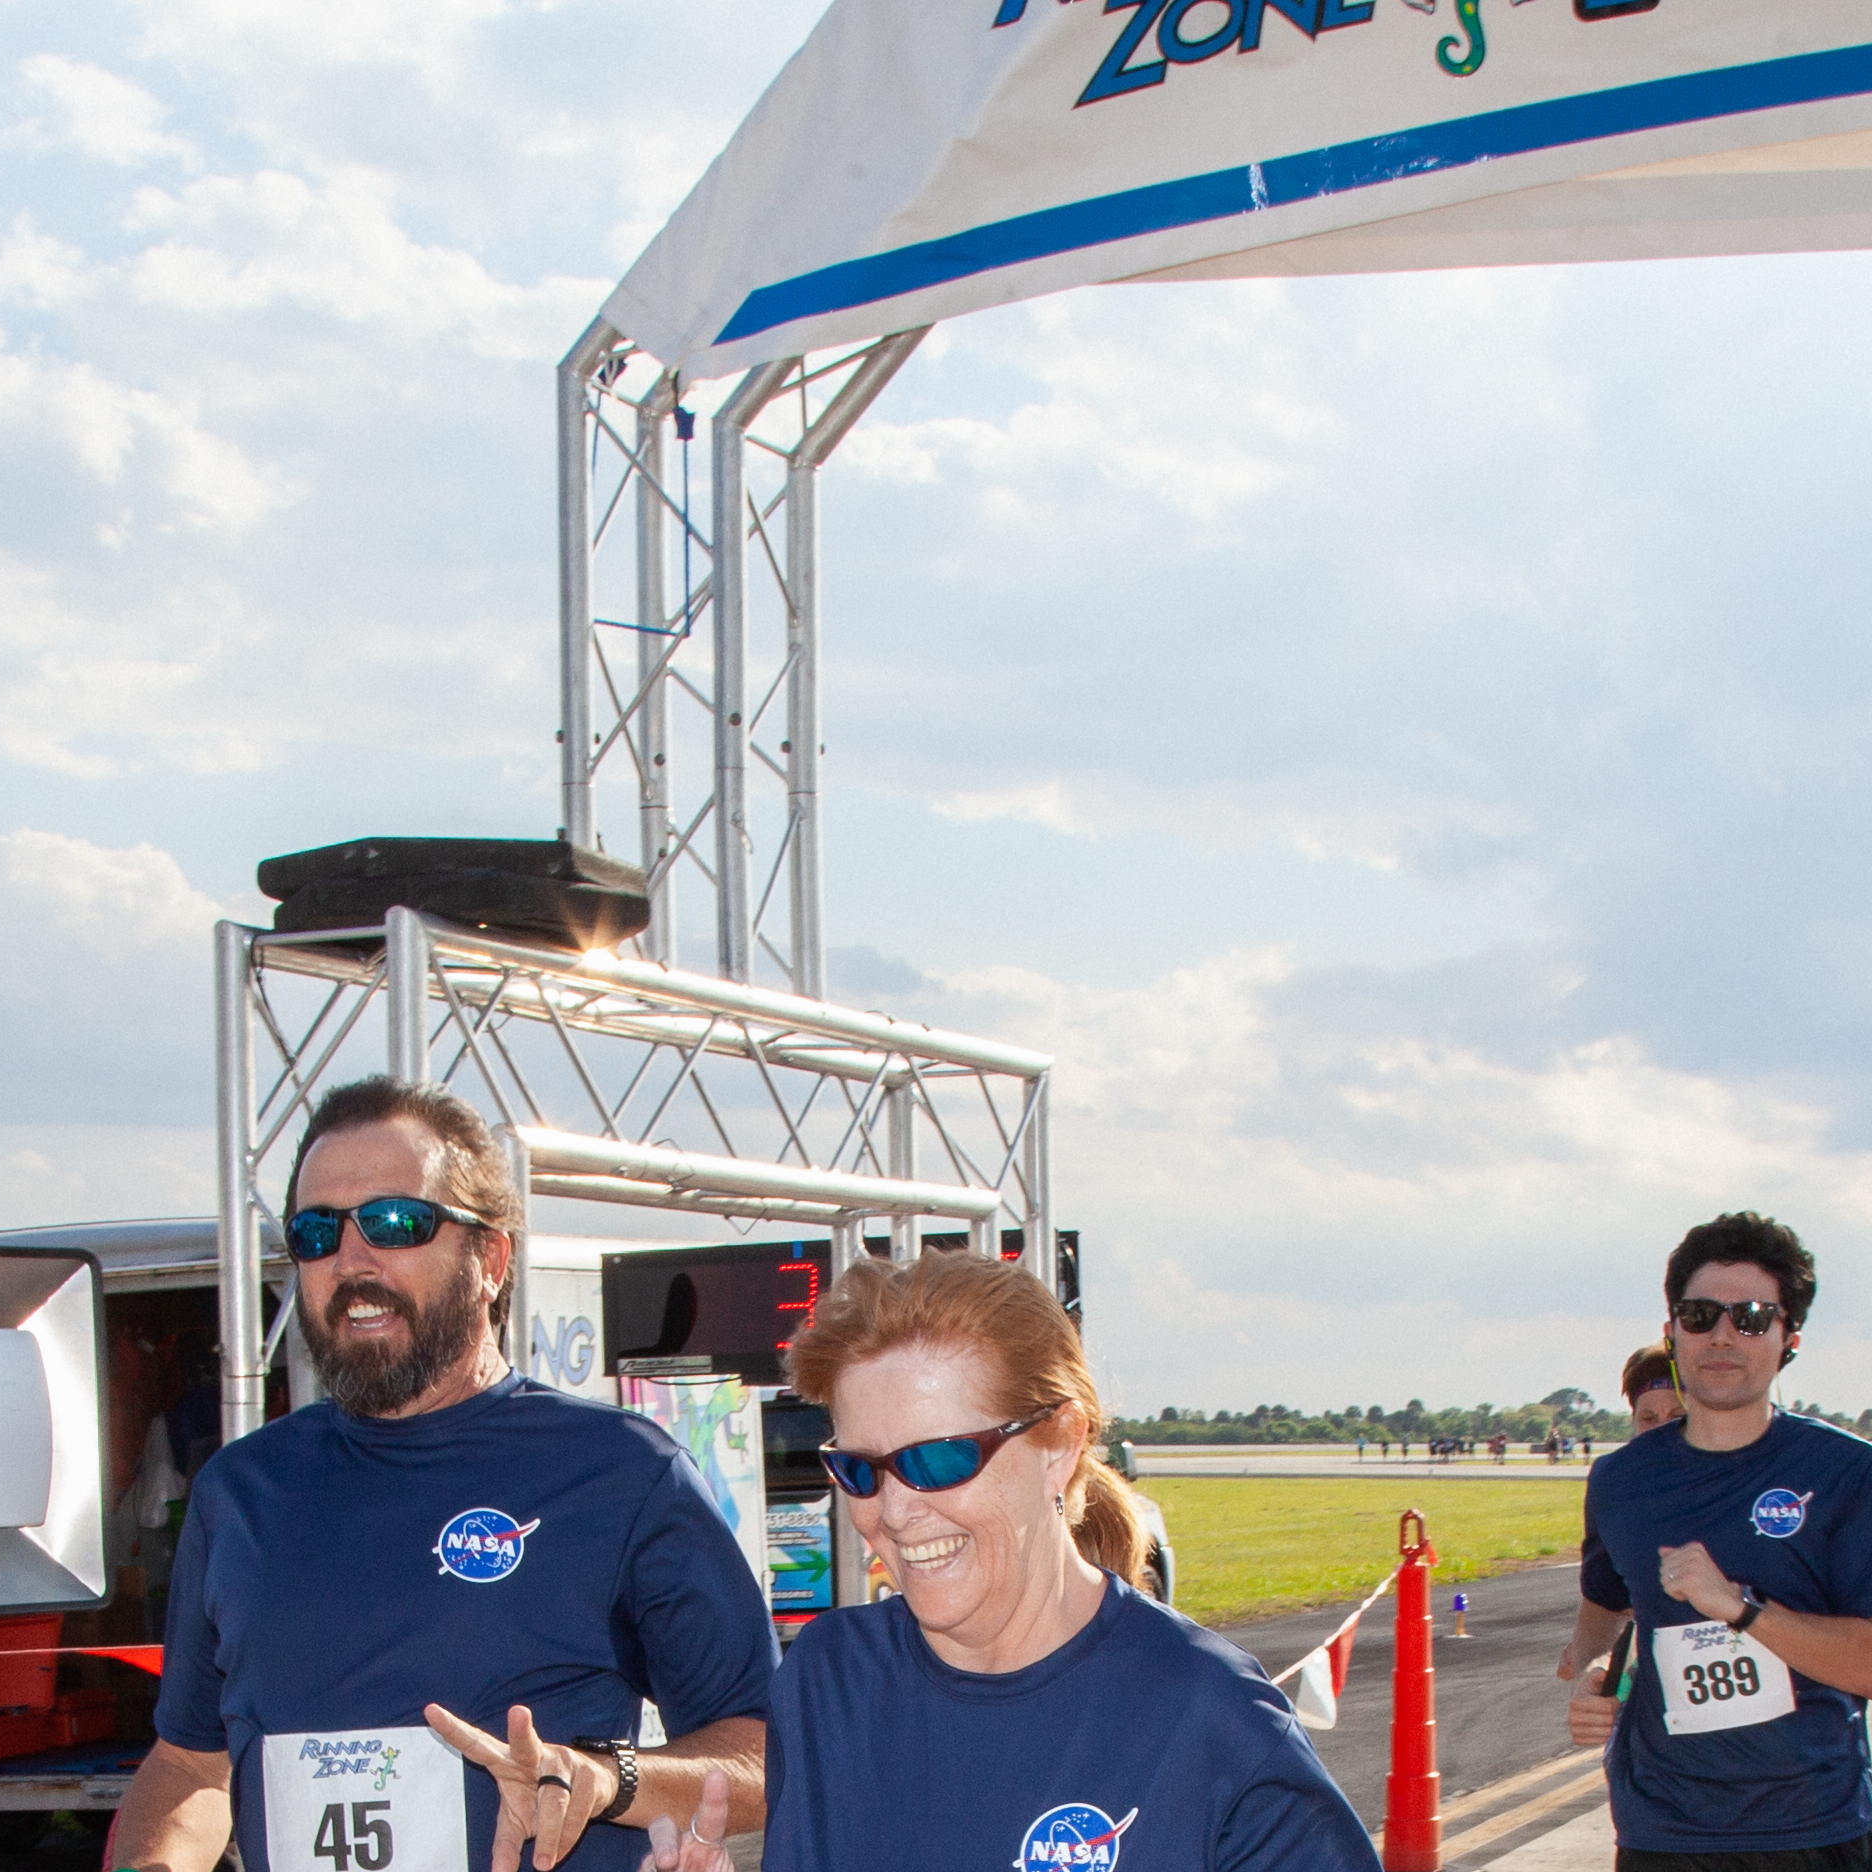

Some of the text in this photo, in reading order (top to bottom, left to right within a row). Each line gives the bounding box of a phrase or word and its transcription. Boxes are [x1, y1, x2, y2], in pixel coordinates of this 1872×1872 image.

[1758, 1507, 1800, 1518] NASA
[447, 1533, 516, 1558] NASA
[1683, 1656, 1760, 1705] 389
[312, 1758, 372, 1779] ZONE
[313, 1800, 393, 1872] 45
[1030, 1841, 1110, 1864] NASA
